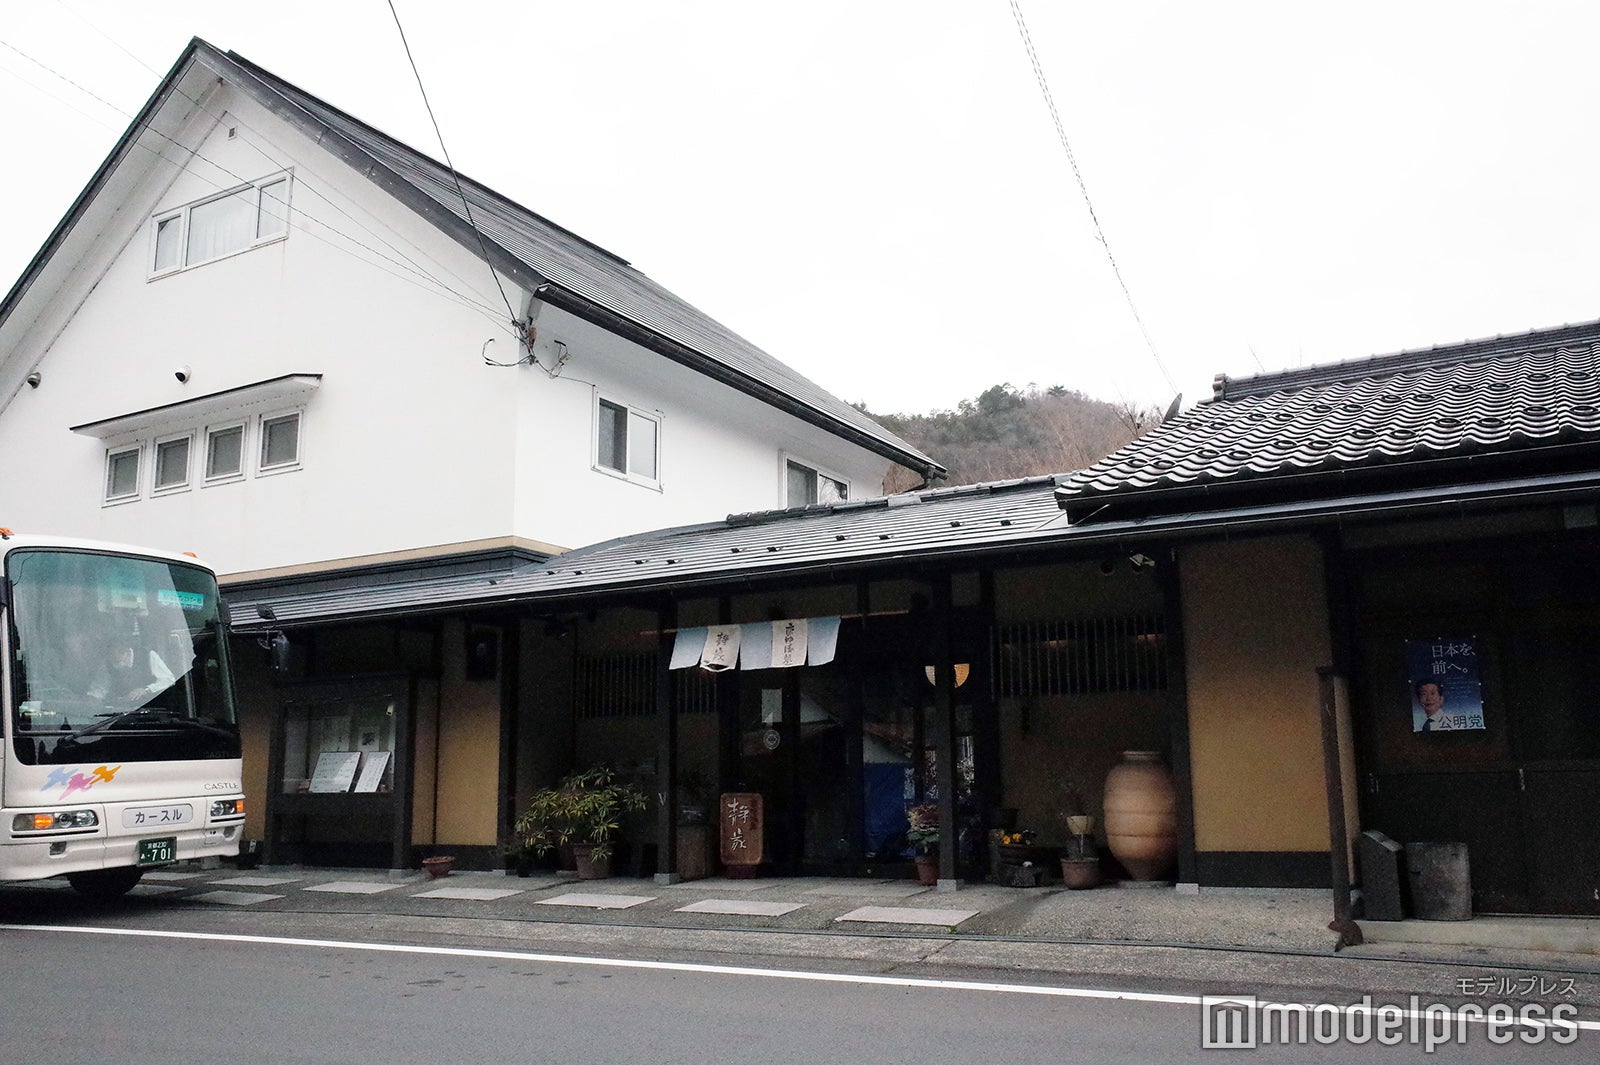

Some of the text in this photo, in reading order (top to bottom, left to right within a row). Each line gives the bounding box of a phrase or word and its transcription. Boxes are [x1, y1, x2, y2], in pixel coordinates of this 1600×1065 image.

[1431, 643, 1477, 658] 日本を、
[1431, 660, 1469, 675] 前へ。
[1438, 714, 1483, 729] 公明党
[204, 782, 239, 791] CASTLE
[135, 809, 183, 824] カースル
